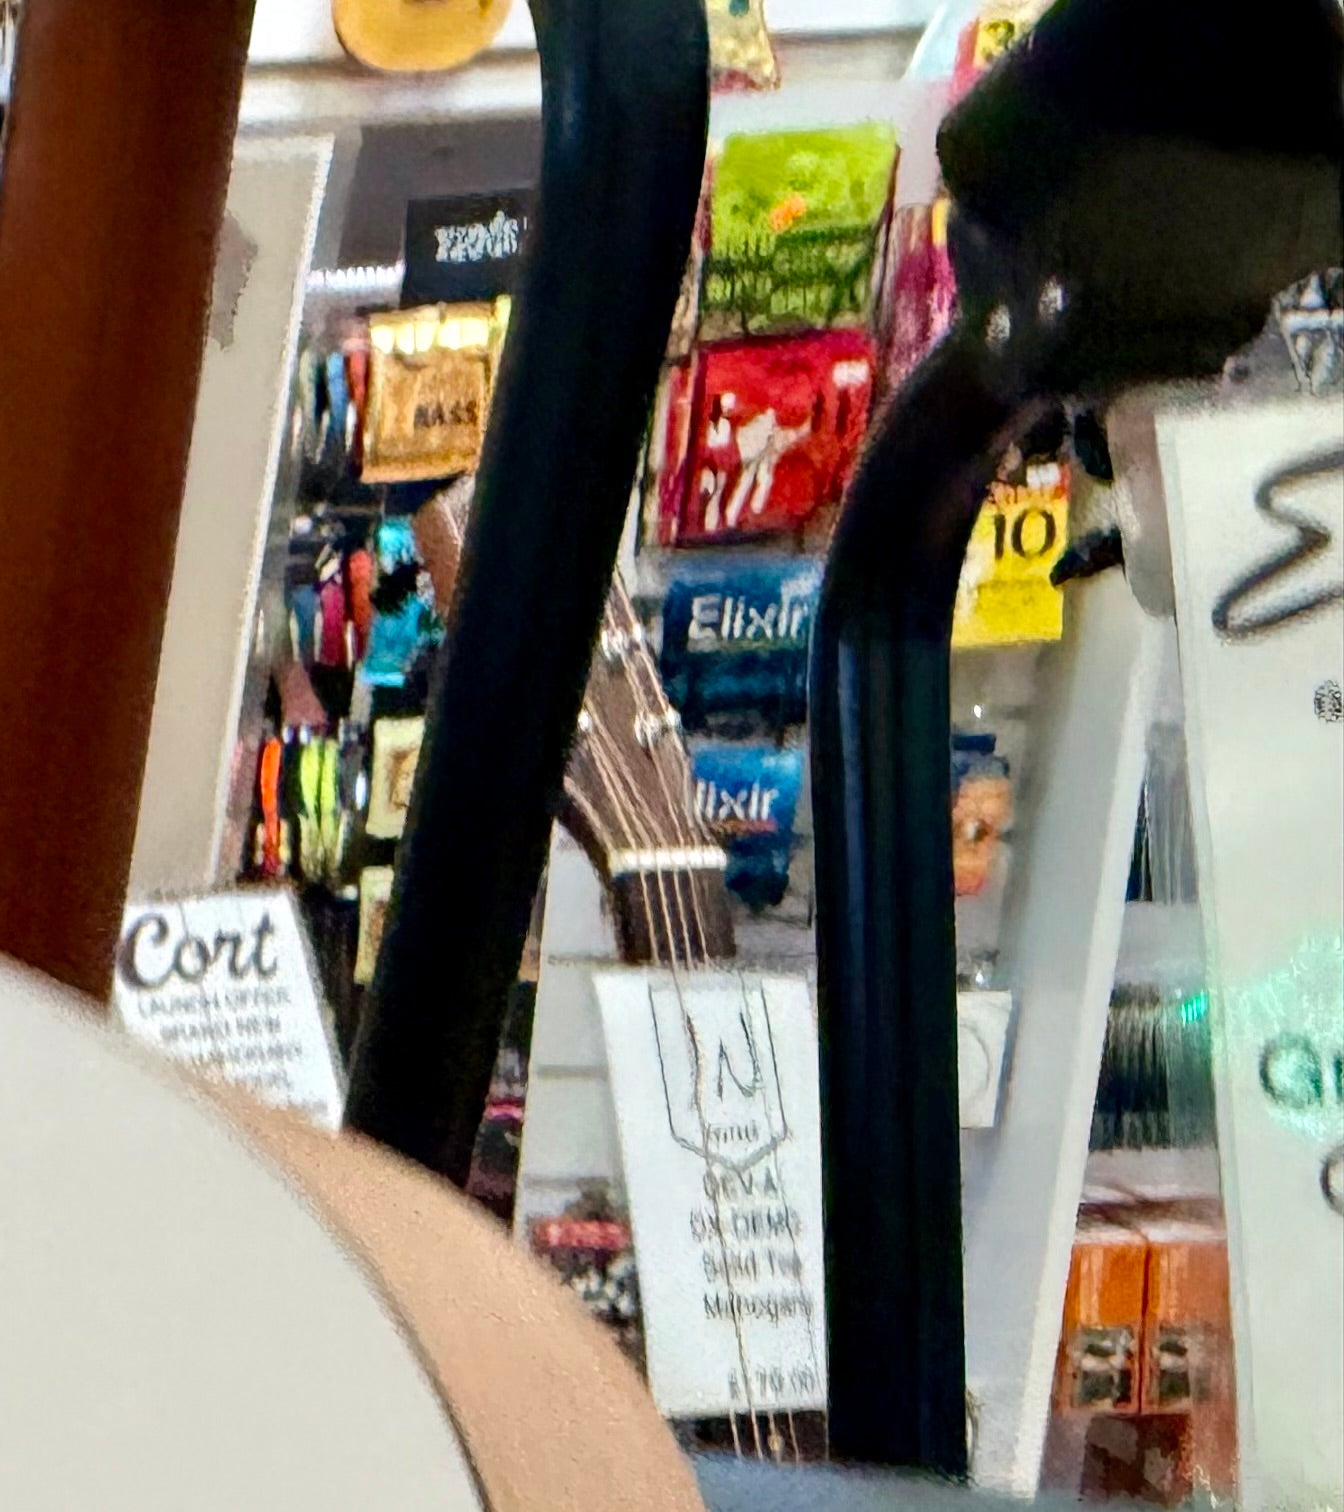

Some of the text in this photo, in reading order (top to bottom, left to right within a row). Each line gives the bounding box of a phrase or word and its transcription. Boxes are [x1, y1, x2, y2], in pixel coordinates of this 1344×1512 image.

[994, 508, 1056, 561] 10
[688, 592, 808, 645] Elixir
[696, 776, 779, 822] lixir
[116, 911, 279, 991] Cort
